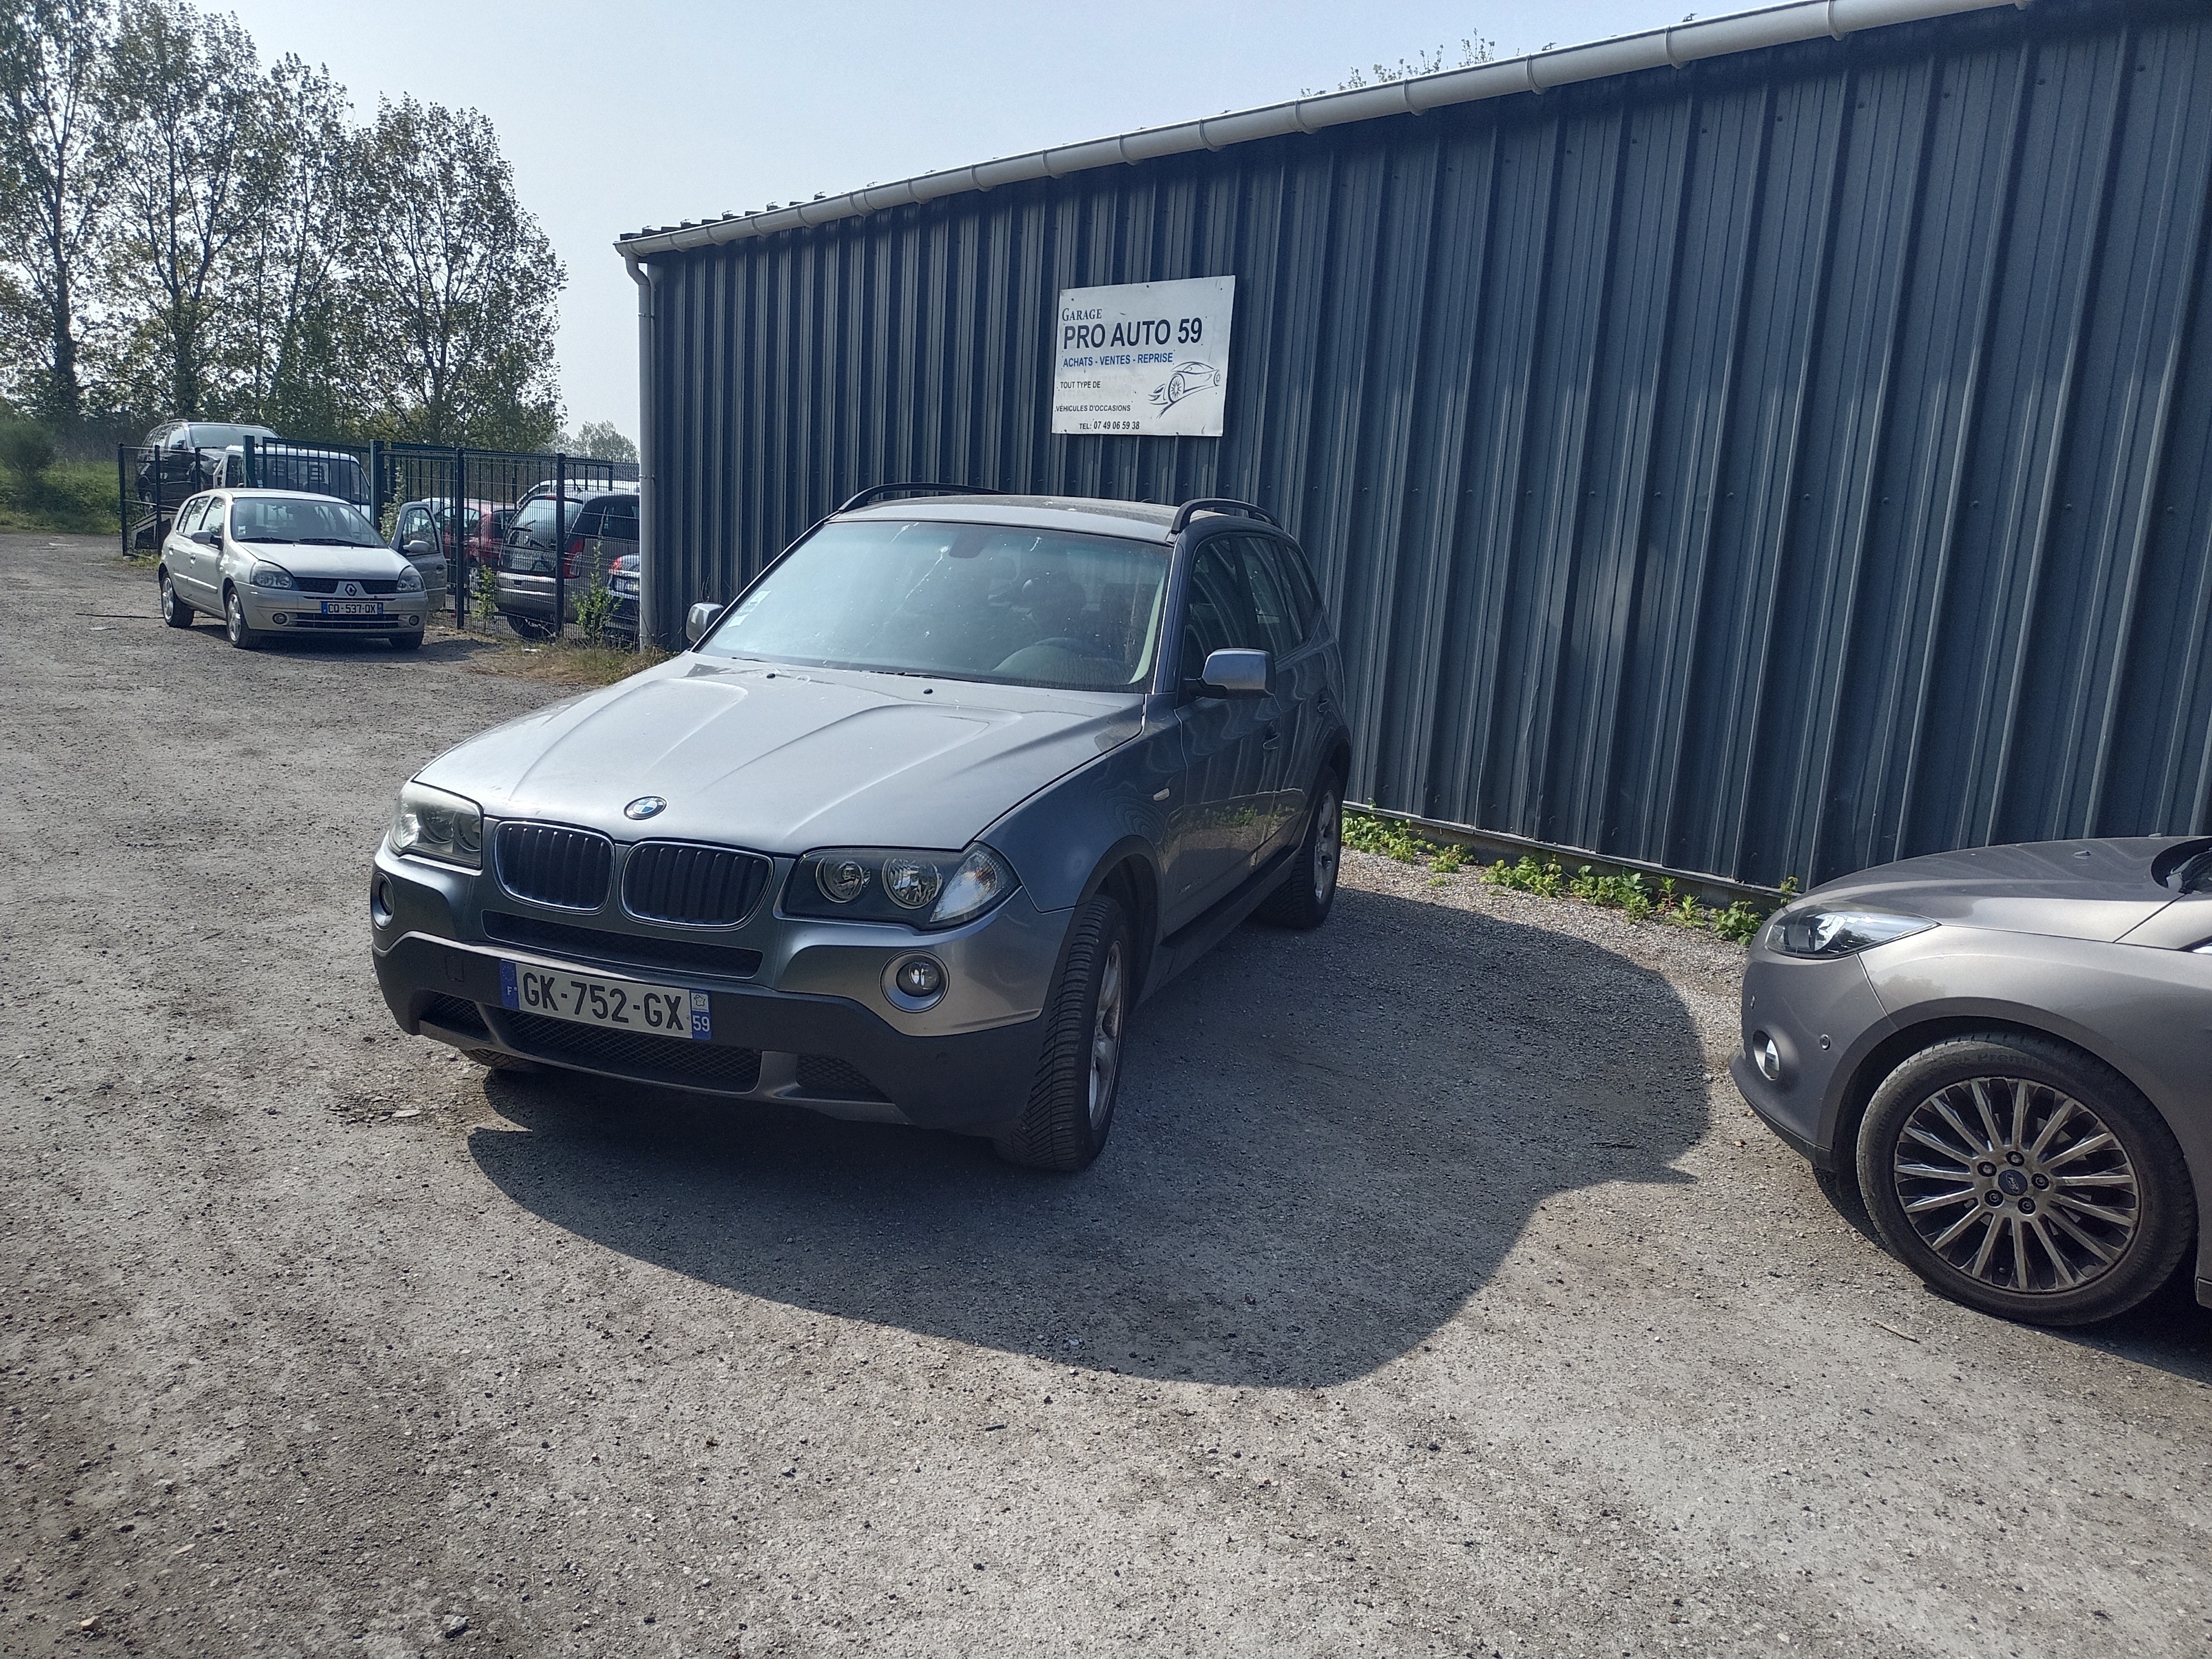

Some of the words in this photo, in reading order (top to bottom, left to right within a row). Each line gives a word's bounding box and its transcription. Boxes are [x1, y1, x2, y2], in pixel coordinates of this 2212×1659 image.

[1064, 324, 1105, 349] PRO
[1110, 319, 1171, 347] AUTO
[1177, 317, 1203, 344] 59
[1063, 357, 1093, 367] ACHATS
[1099, 354, 1130, 365] VENTES
[1138, 352, 1173, 363] REPRISE
[1094, 421, 1102, 429] 07
[1103, 421, 1111, 429] 49
[1113, 421, 1120, 430] 06
[1122, 421, 1130, 430] 59
[1131, 421, 1140, 430] 38
[507, 986, 512, 995] F
[523, 972, 684, 1031] GK-752-GX
[692, 1015, 710, 1032] 59
